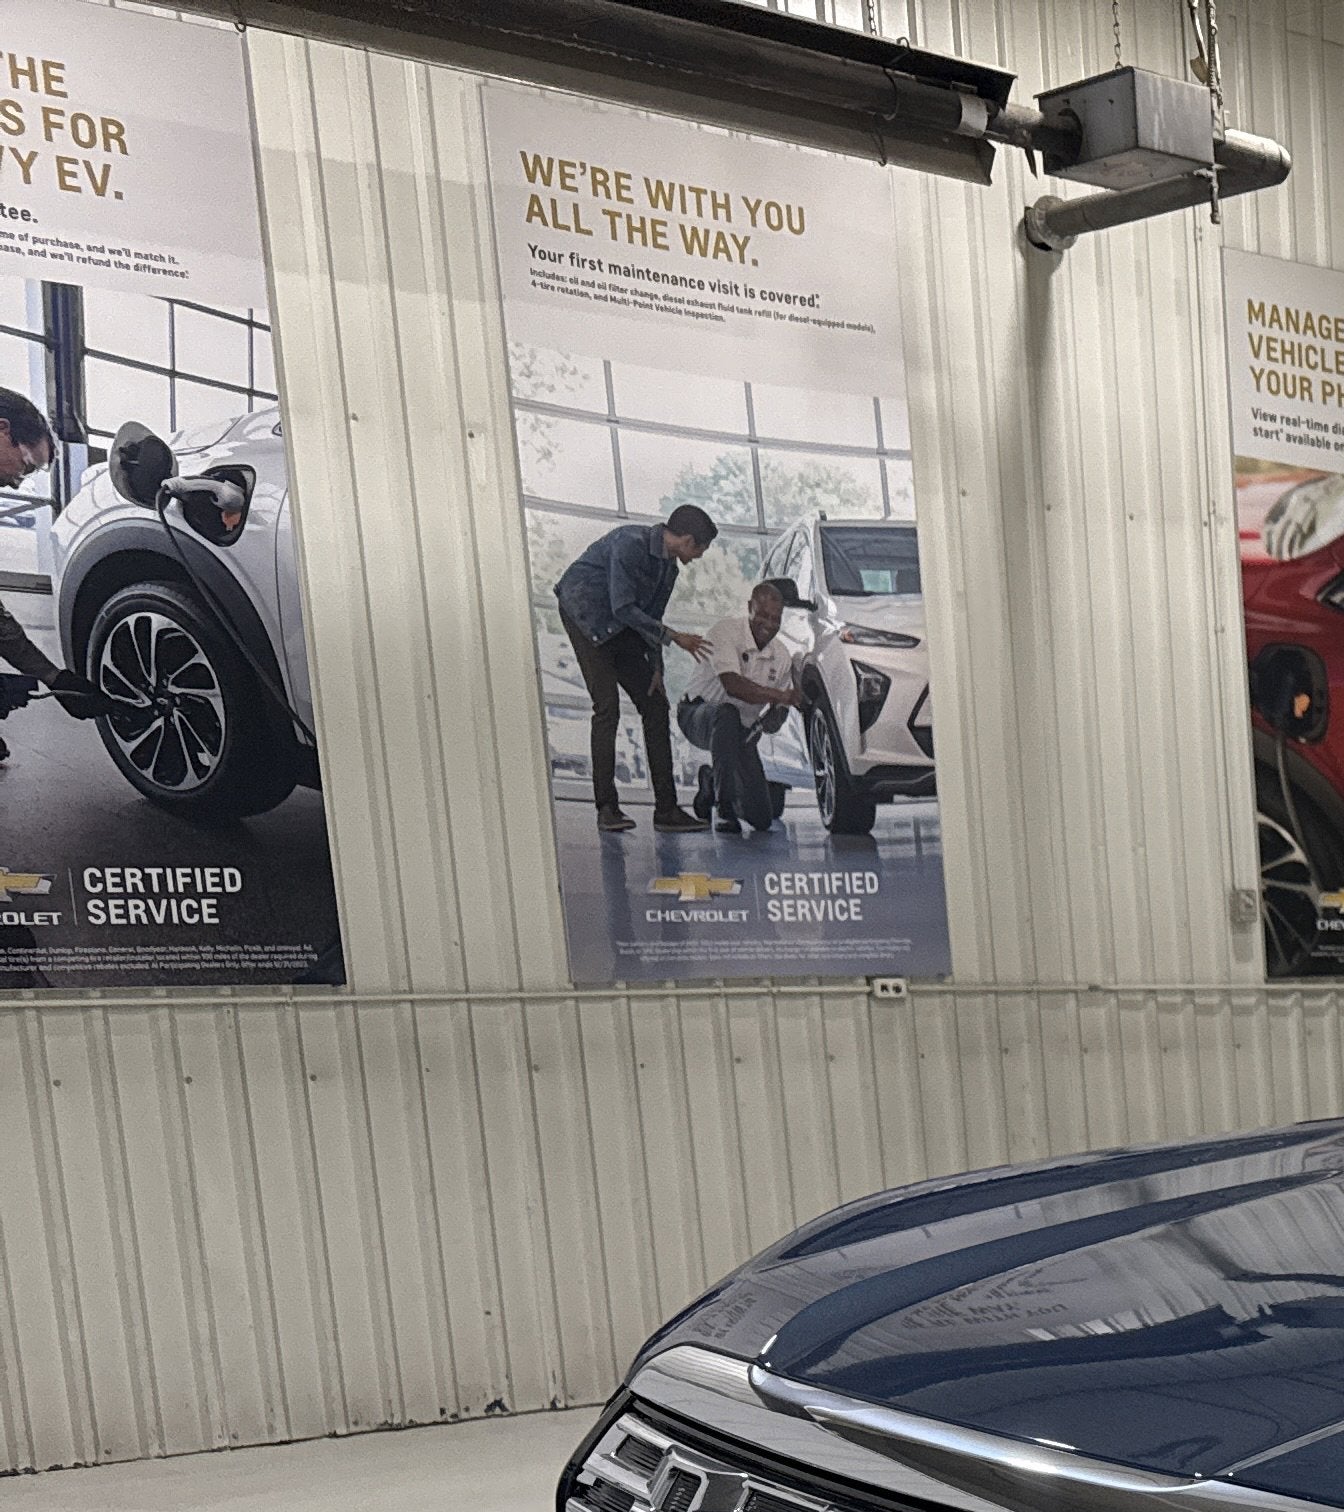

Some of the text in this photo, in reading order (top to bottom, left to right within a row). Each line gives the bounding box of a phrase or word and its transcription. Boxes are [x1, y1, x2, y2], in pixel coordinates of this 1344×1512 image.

[0, 51, 68, 99] HE
[41, 106, 129, 156] FOR
[0, 146, 124, 200] Y EV.
[519, 150, 805, 236] WE'RE WITH YOU
[525, 193, 759, 267] ALL THE WAY.
[0, 244, 25, 257] ase,
[76, 255, 111, 268] refund
[114, 260, 131, 271] the
[134, 251, 166, 264] match
[527, 242, 566, 265] Your
[568, 250, 604, 273] first
[608, 261, 705, 292] maintenance
[707, 278, 740, 297] visit
[743, 283, 756, 300] is
[1250, 365, 1313, 403] YOUR
[1251, 407, 1277, 424] View
[1280, 415, 1332, 433] real-time
[1286, 432, 1331, 450] available
[83, 867, 242, 893] CERTIFIED
[764, 871, 879, 895] CERTIFIED
[0, 911, 62, 926] OLET
[87, 899, 220, 925] SERVICE
[645, 909, 749, 923] CHEVROLET
[767, 899, 863, 923] SERVICE
